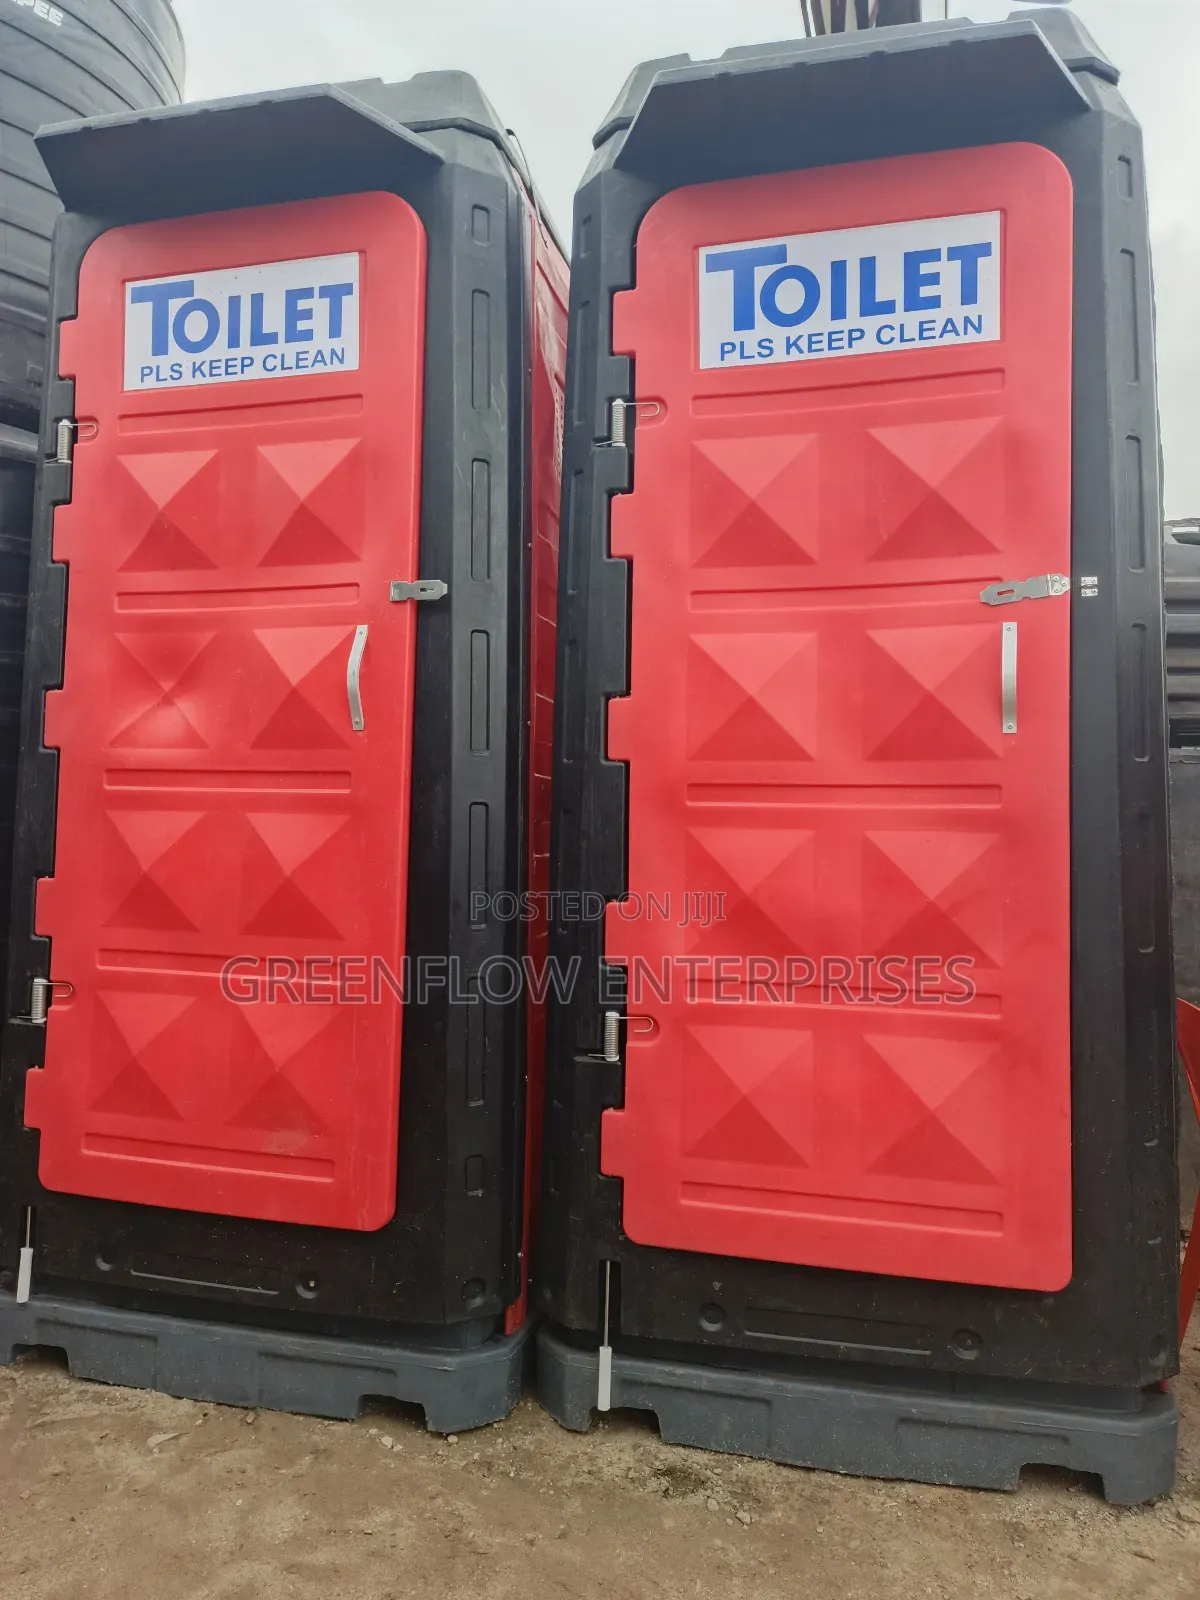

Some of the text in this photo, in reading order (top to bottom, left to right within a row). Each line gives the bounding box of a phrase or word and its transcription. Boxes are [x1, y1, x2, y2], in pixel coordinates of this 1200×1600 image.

[705, 241, 992, 332] TOILET
[130, 279, 354, 357] TOILET
[720, 314, 983, 361] PLS KEEP CLEAN
[140, 347, 345, 383] PLS KEEP CLEAN
